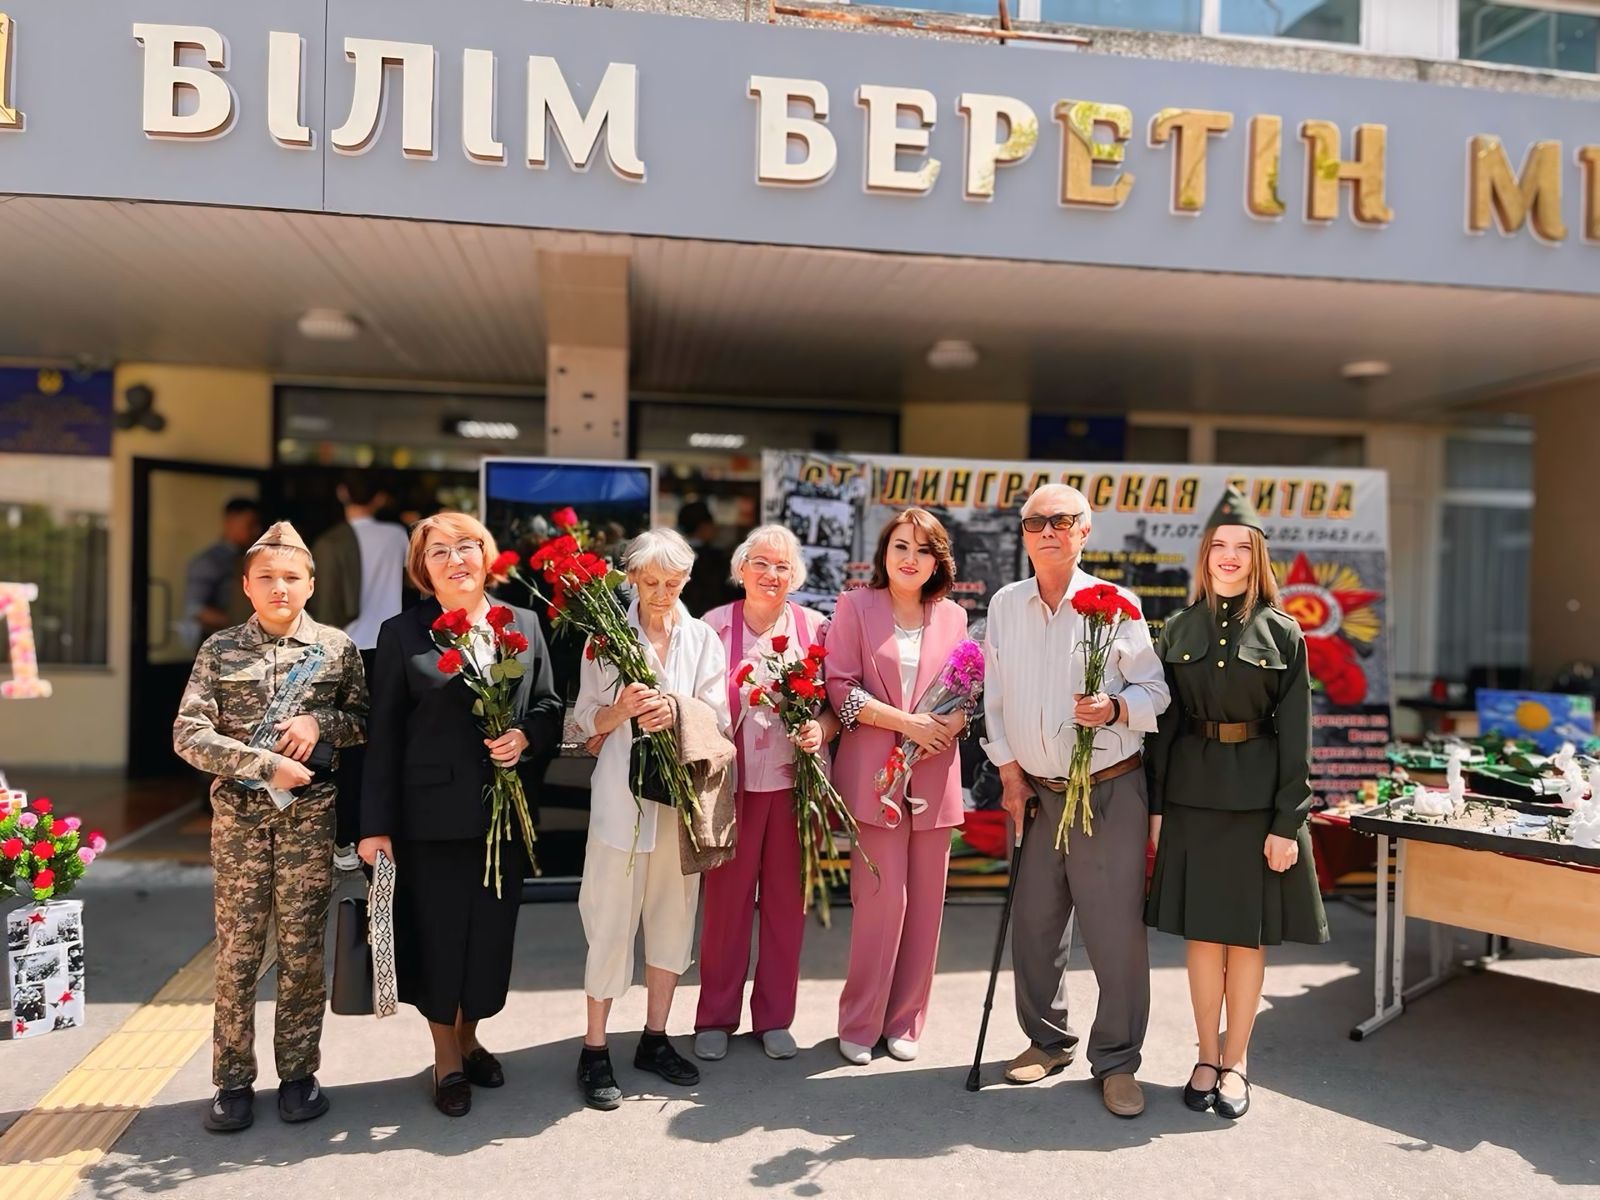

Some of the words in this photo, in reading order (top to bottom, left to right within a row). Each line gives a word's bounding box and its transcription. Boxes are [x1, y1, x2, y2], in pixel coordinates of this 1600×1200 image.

[133, 22, 646, 182] БІЛІМ
[748, 74, 1395, 226] БЕРЕТІН
[1150, 523, 1203, 539] 17.07.
